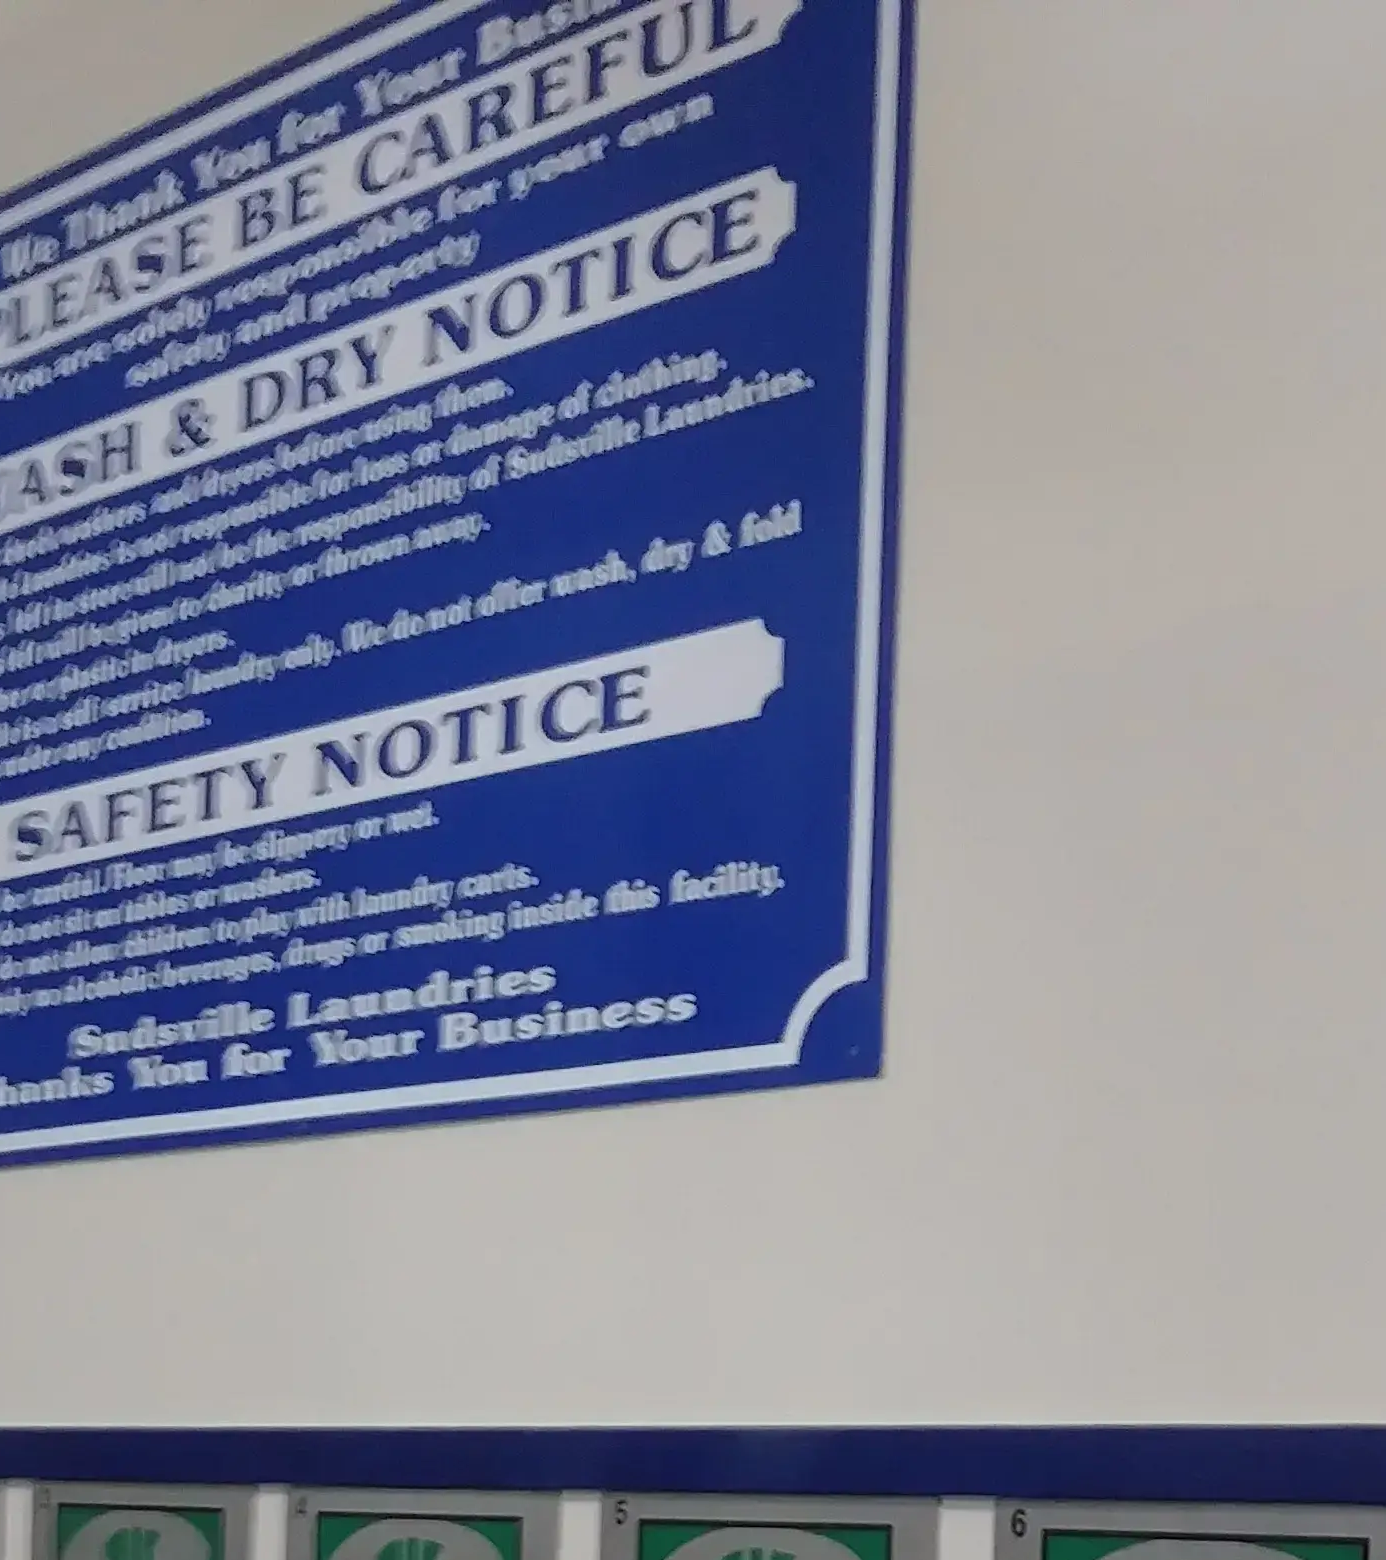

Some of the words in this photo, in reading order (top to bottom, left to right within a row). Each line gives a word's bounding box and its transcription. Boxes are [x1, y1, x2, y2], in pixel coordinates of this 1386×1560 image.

[355, 48, 465, 115] Your
[236, 158, 329, 255] BE
[354, 0, 762, 206] CAREFUL
[167, 386, 220, 461] &
[241, 320, 396, 435] DRY
[422, 183, 763, 371] NOTICE
[435, 379, 513, 417] them.
[551, 552, 636, 596] wash,
[642, 538, 693, 572] dry
[702, 521, 730, 555] &
[741, 501, 801, 546] fold
[13, 752, 279, 863] SAFETY
[312, 663, 655, 798] NOTICE
[394, 910, 504, 947] smoking
[508, 889, 598, 928] inside
[605, 880, 660, 913] this
[672, 862, 784, 902] facility.
[457, 864, 538, 897] carts.
[70, 1002, 274, 1057] Sudsville
[288, 966, 555, 1027] Laundries
[129, 1055, 208, 1087] You
[223, 1043, 291, 1077] for
[311, 1030, 424, 1065] Your
[439, 994, 696, 1050] Business
[615, 1502, 627, 1525] 5
[1010, 1511, 1027, 1537] 6
